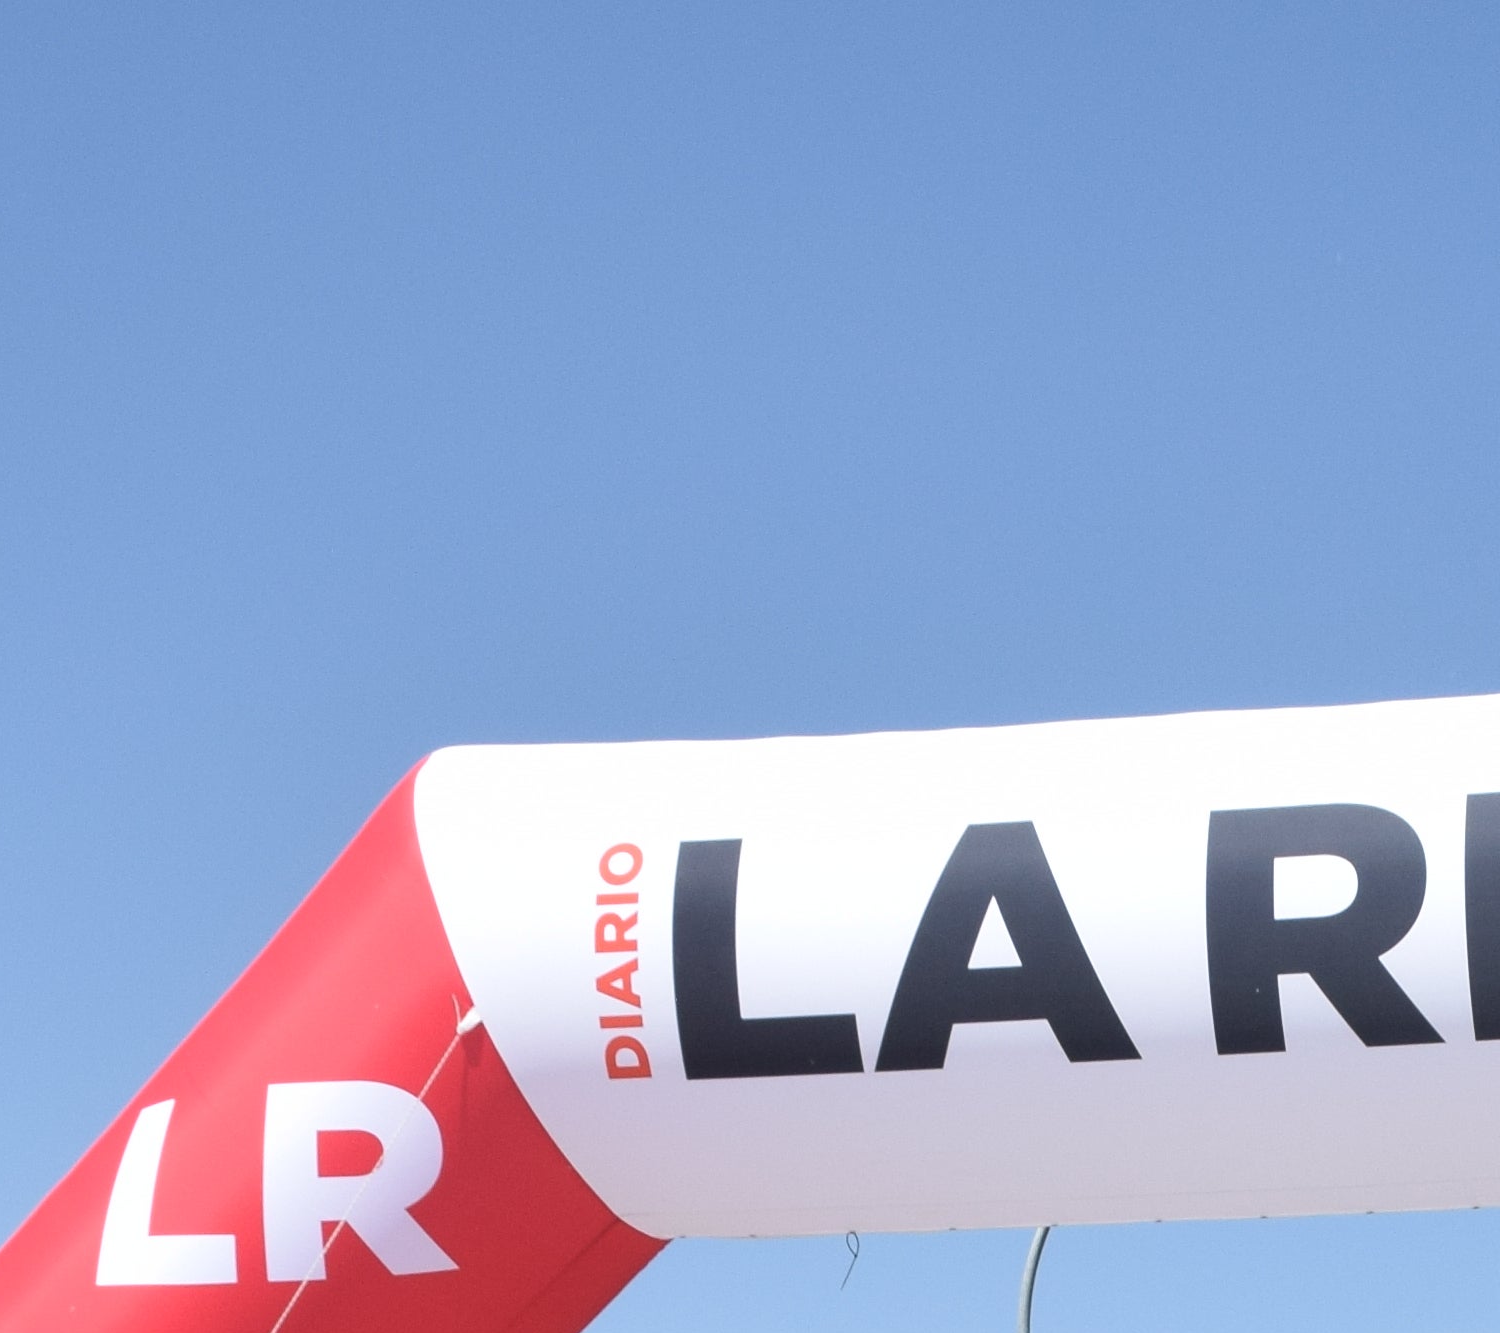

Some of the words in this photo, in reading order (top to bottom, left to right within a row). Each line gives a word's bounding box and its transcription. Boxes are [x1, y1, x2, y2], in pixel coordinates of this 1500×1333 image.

[595, 842, 654, 1082] DIARIO
[672, 819, 1143, 1082] LA
[95, 1080, 461, 1286] LR
